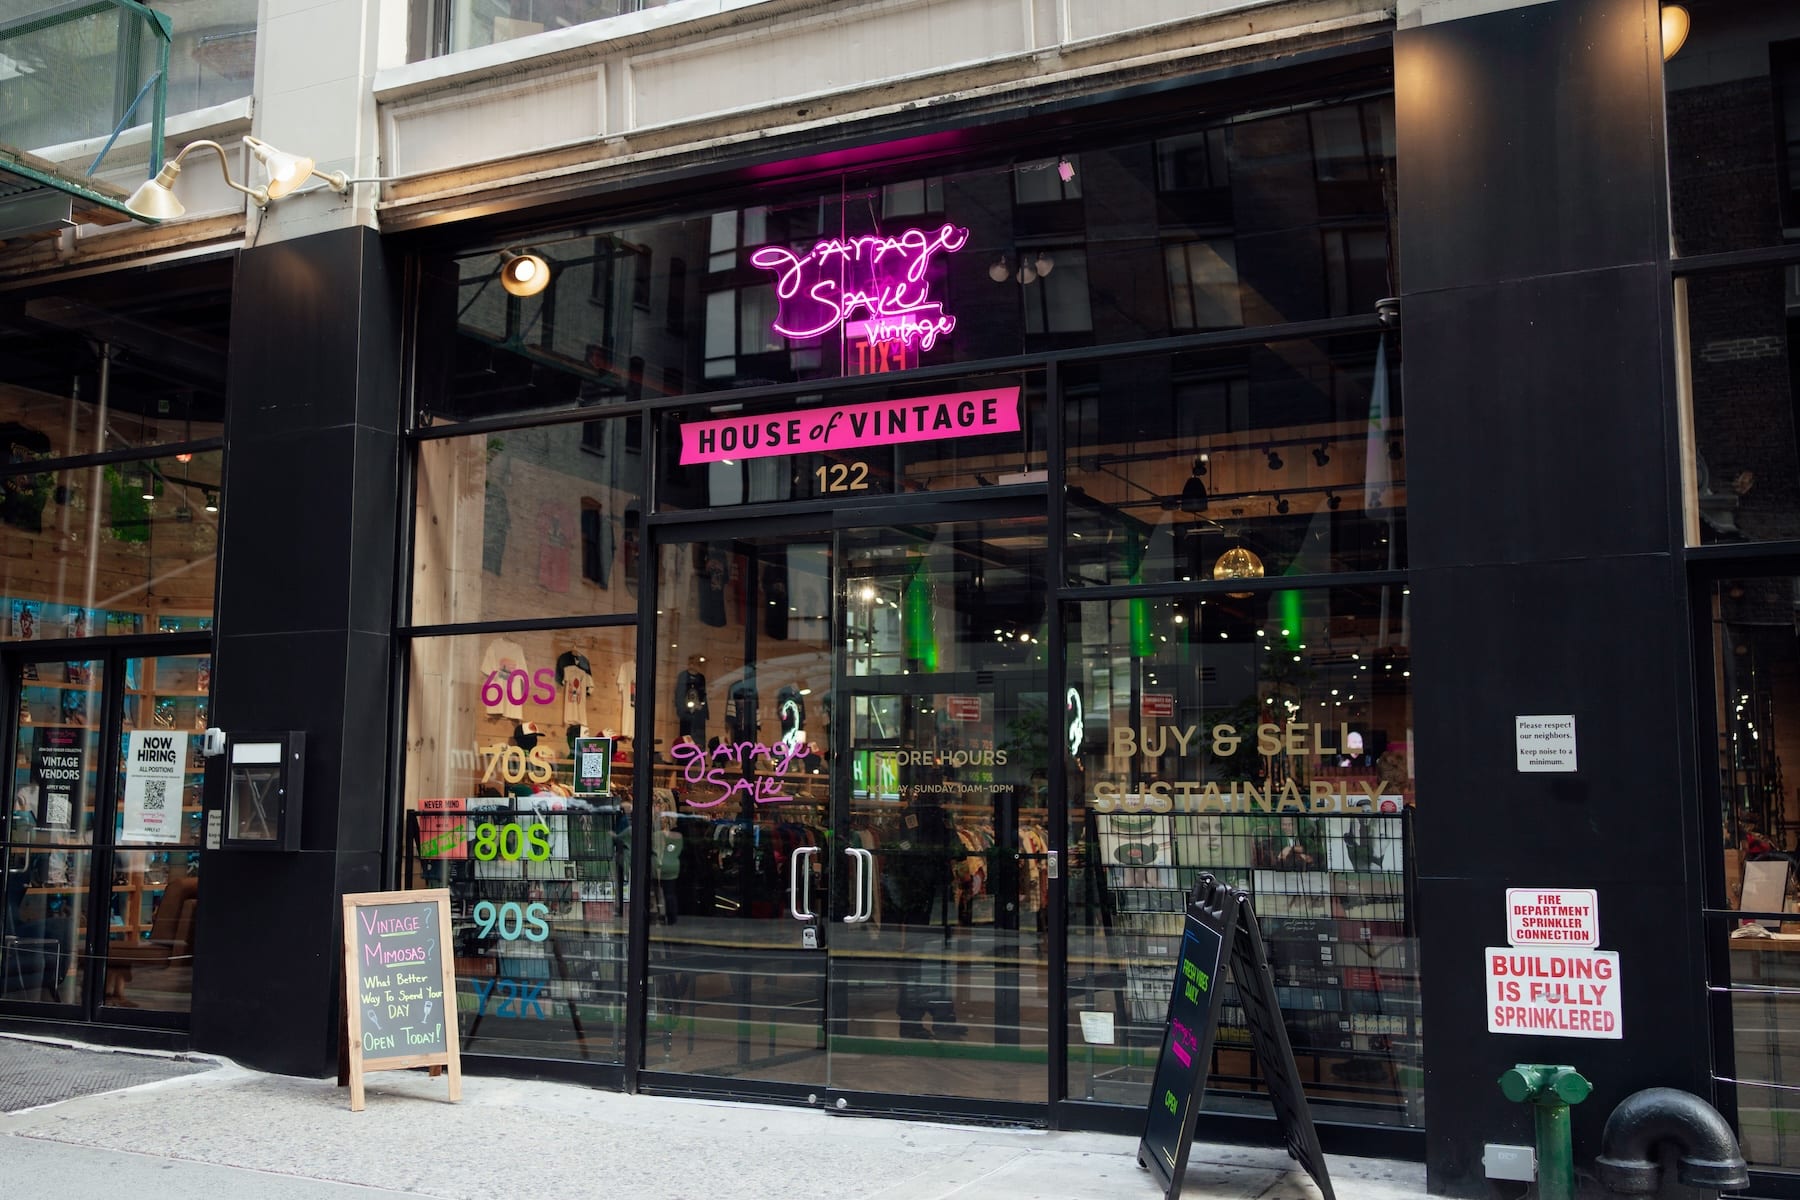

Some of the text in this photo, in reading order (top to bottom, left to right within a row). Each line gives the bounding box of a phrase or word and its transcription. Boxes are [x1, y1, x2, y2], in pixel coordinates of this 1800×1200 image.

[699, 398, 998, 454] HOUSE of VINTAGE
[815, 461, 869, 493] 122
[481, 668, 556, 707] 60S
[1545, 722, 1571, 730] respect
[143, 737, 173, 749] NOW
[1113, 722, 1363, 758] BUY & SELL
[1534, 732, 1572, 741] neighbors.
[137, 750, 176, 763] HIRING
[874, 750, 1008, 766] STORE HOURS
[1520, 748, 1537, 756] Keep
[42, 756, 79, 767] VINTAGE
[479, 745, 552, 784] 70S
[40, 768, 80, 780] VENDORS
[914, 784, 953, 793] SUNDAY
[424, 800, 443, 809] NEVER
[1093, 781, 1390, 814] SUSTAINABLY
[474, 823, 551, 862] 80S
[1537, 895, 1561, 904] FIRE
[1514, 906, 1590, 916] DEPARTMENT
[473, 901, 549, 942] 90S
[1522, 917, 1582, 928] SPRINKLER
[1516, 929, 1589, 940] CONNECTION
[1492, 955, 1612, 980] BUILDING
[364, 973, 428, 989] What Better
[361, 986, 443, 1007] Way To Spend Your
[471, 977, 545, 1020] Y2K
[1498, 981, 1607, 1006] IS FULLY
[388, 1004, 410, 1019] DAY
[1494, 1006, 1615, 1032] SPRINKLERED
[363, 1032, 395, 1051] OPEN
[1165, 1089, 1178, 1116] OPEN
